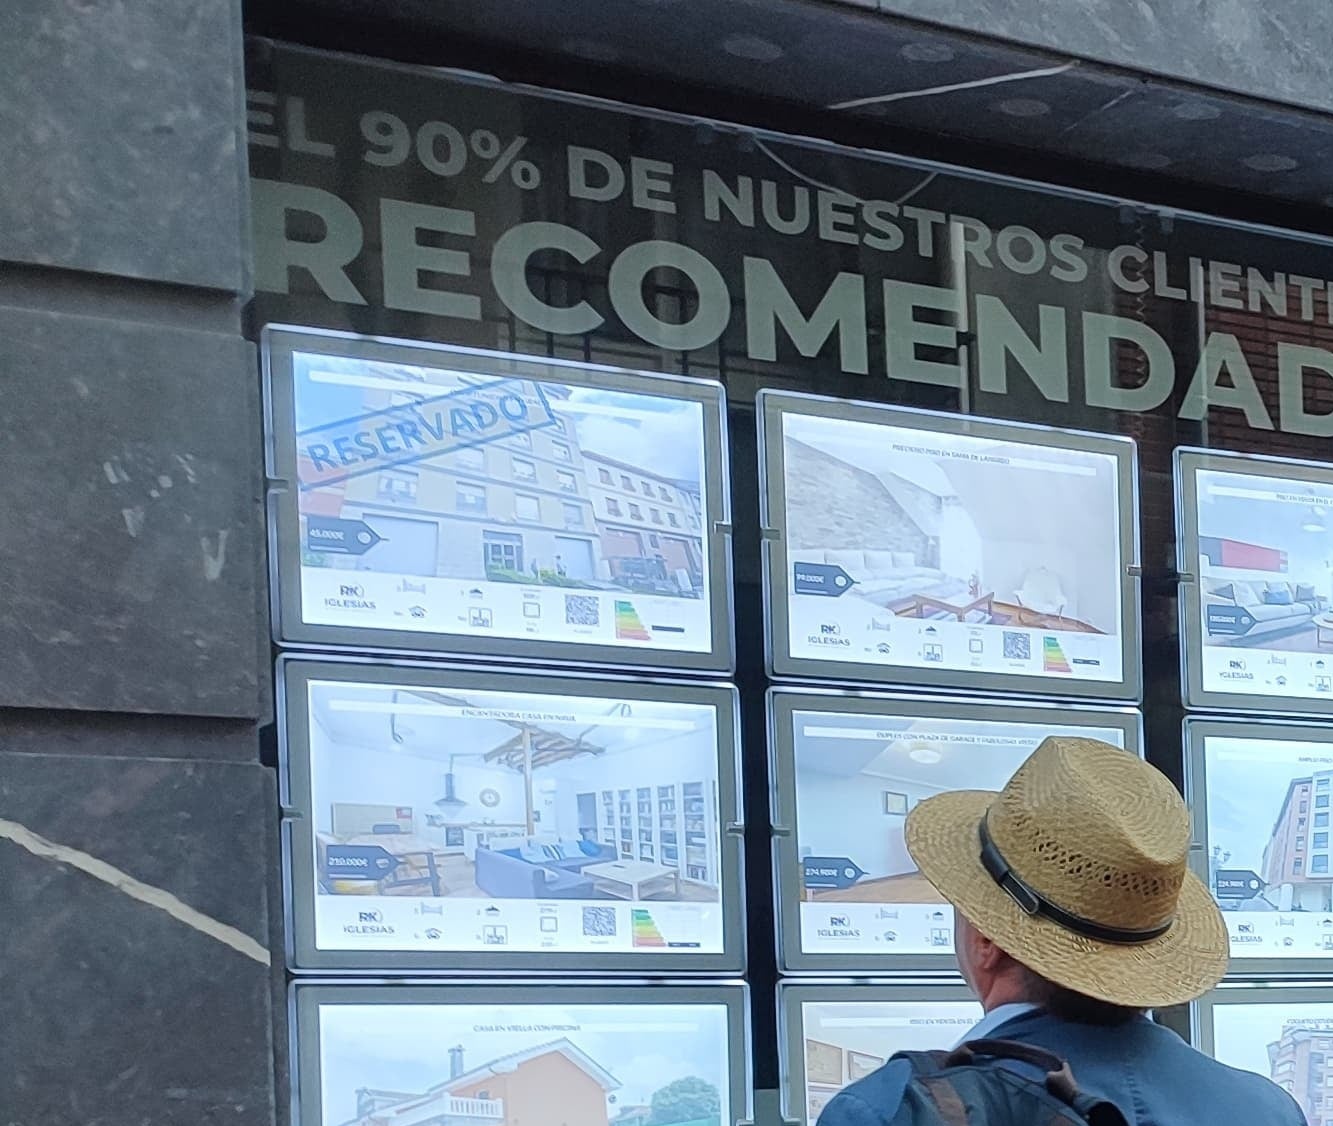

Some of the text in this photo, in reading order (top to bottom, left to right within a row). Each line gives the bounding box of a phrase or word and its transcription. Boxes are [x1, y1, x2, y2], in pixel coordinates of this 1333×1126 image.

[246, 90, 335, 157] EL
[360, 110, 541, 190] 90%
[566, 145, 678, 214] DE
[703, 168, 1088, 284] NUESTROS
[307, 394, 529, 473] RESERVADO
